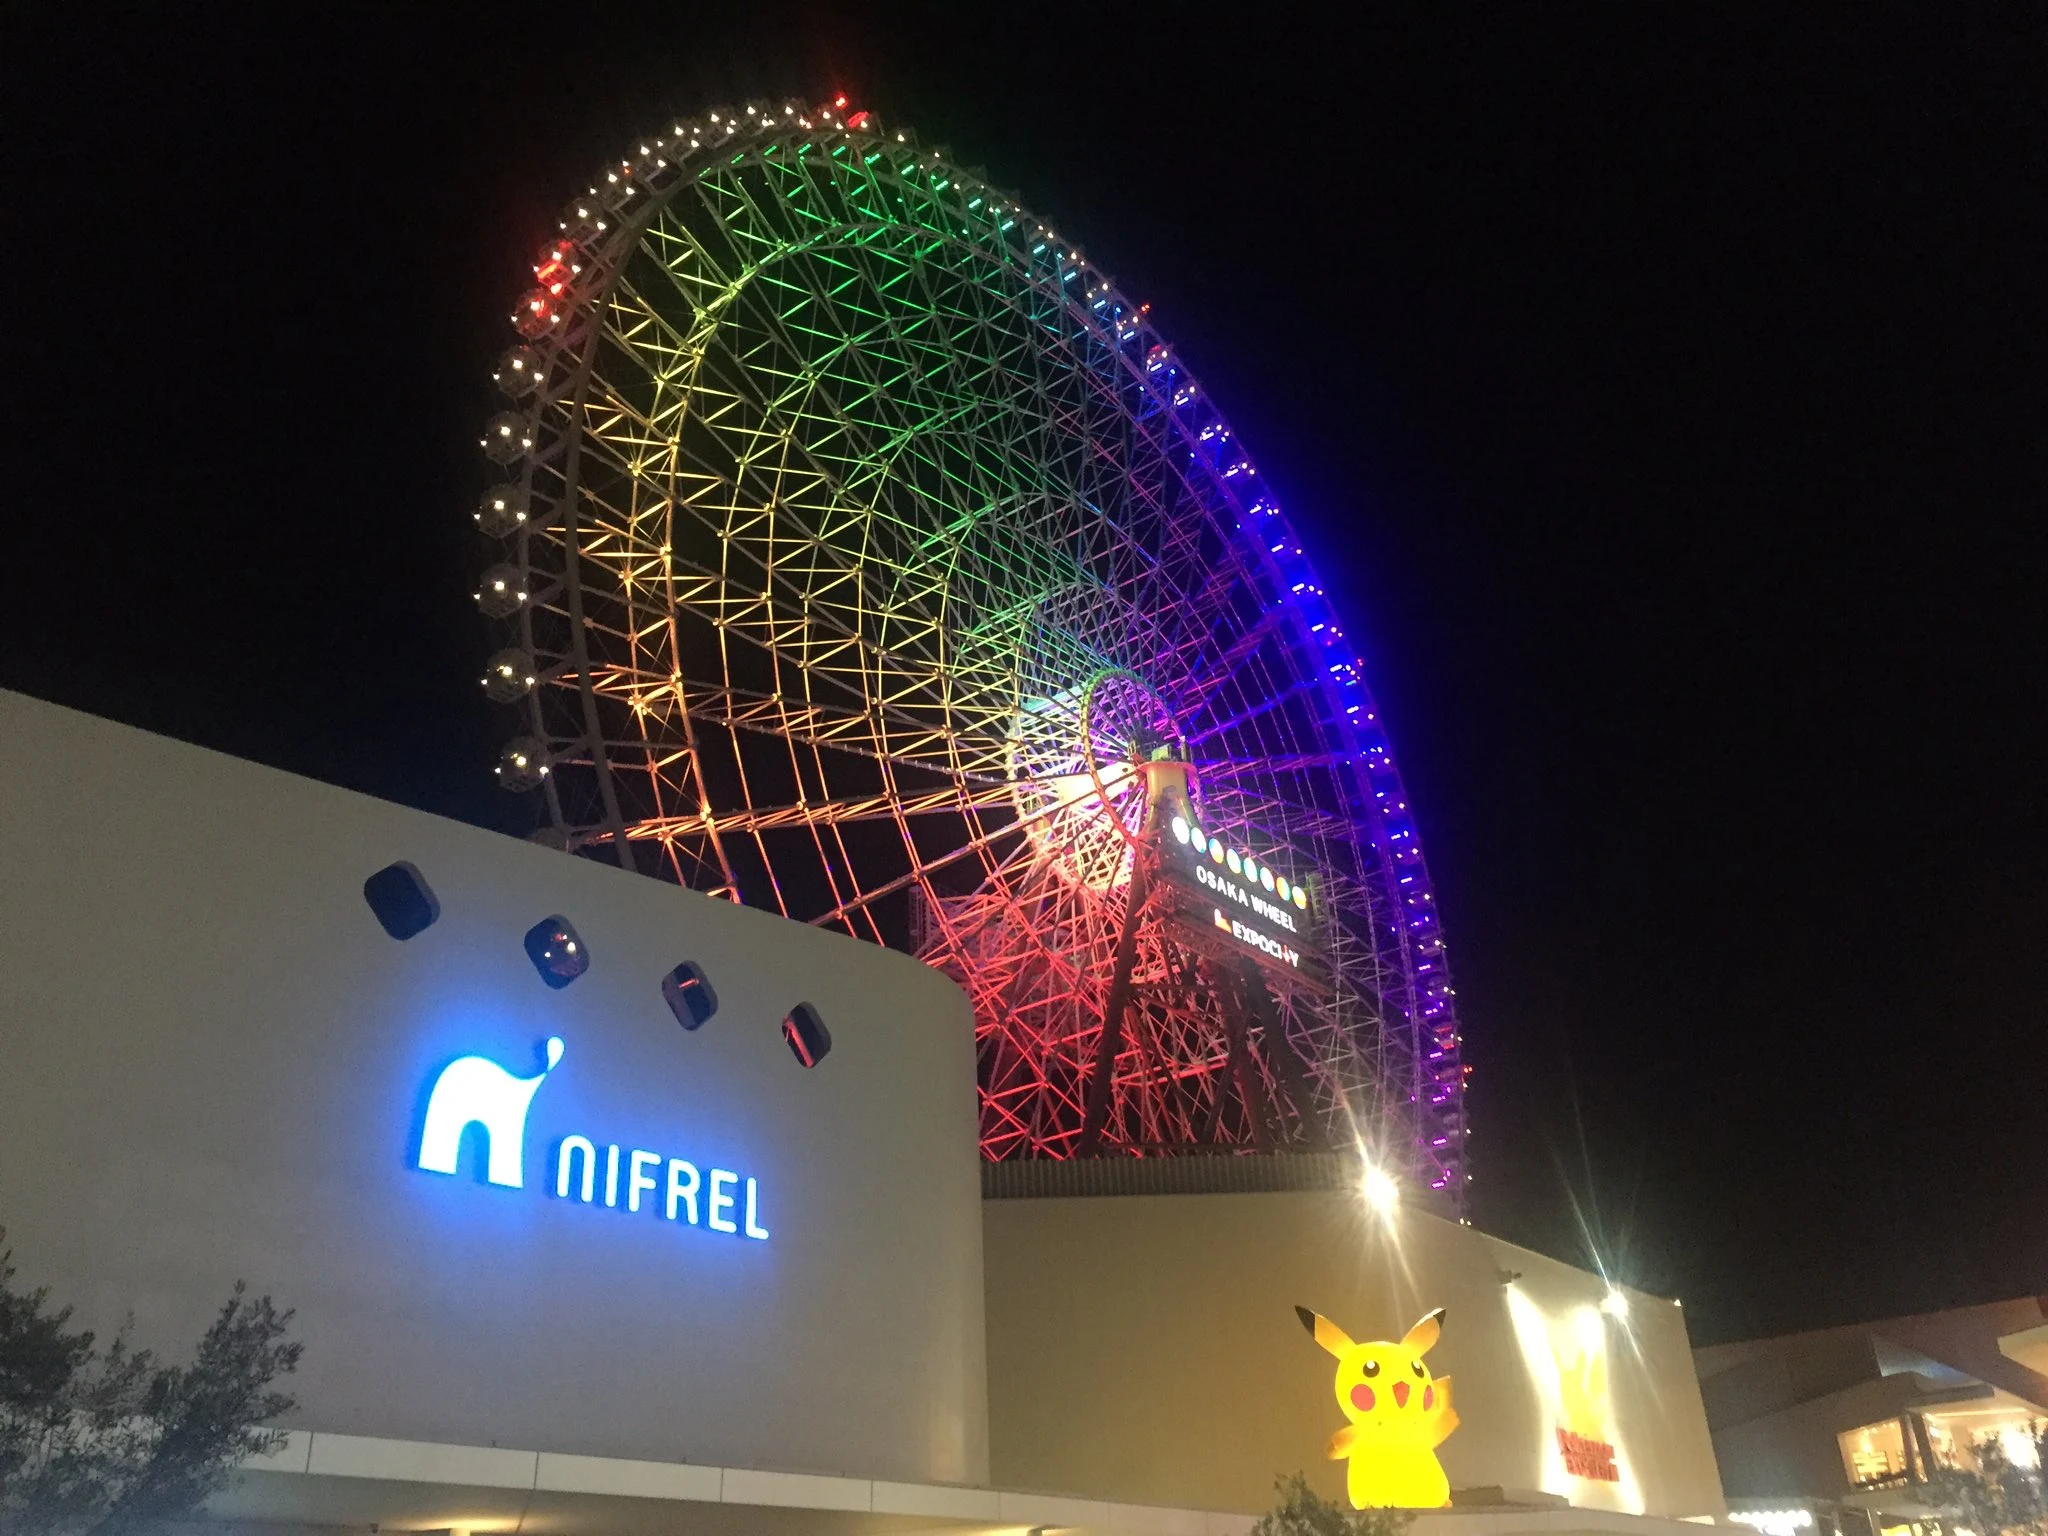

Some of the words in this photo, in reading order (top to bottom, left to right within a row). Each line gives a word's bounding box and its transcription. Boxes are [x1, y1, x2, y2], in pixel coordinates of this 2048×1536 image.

[1196, 865, 1249, 907] OSAKA
[1250, 894, 1298, 933] WHEEL
[1231, 920, 1299, 968] EXPOCITY
[556, 1134, 770, 1241] NIFREL
